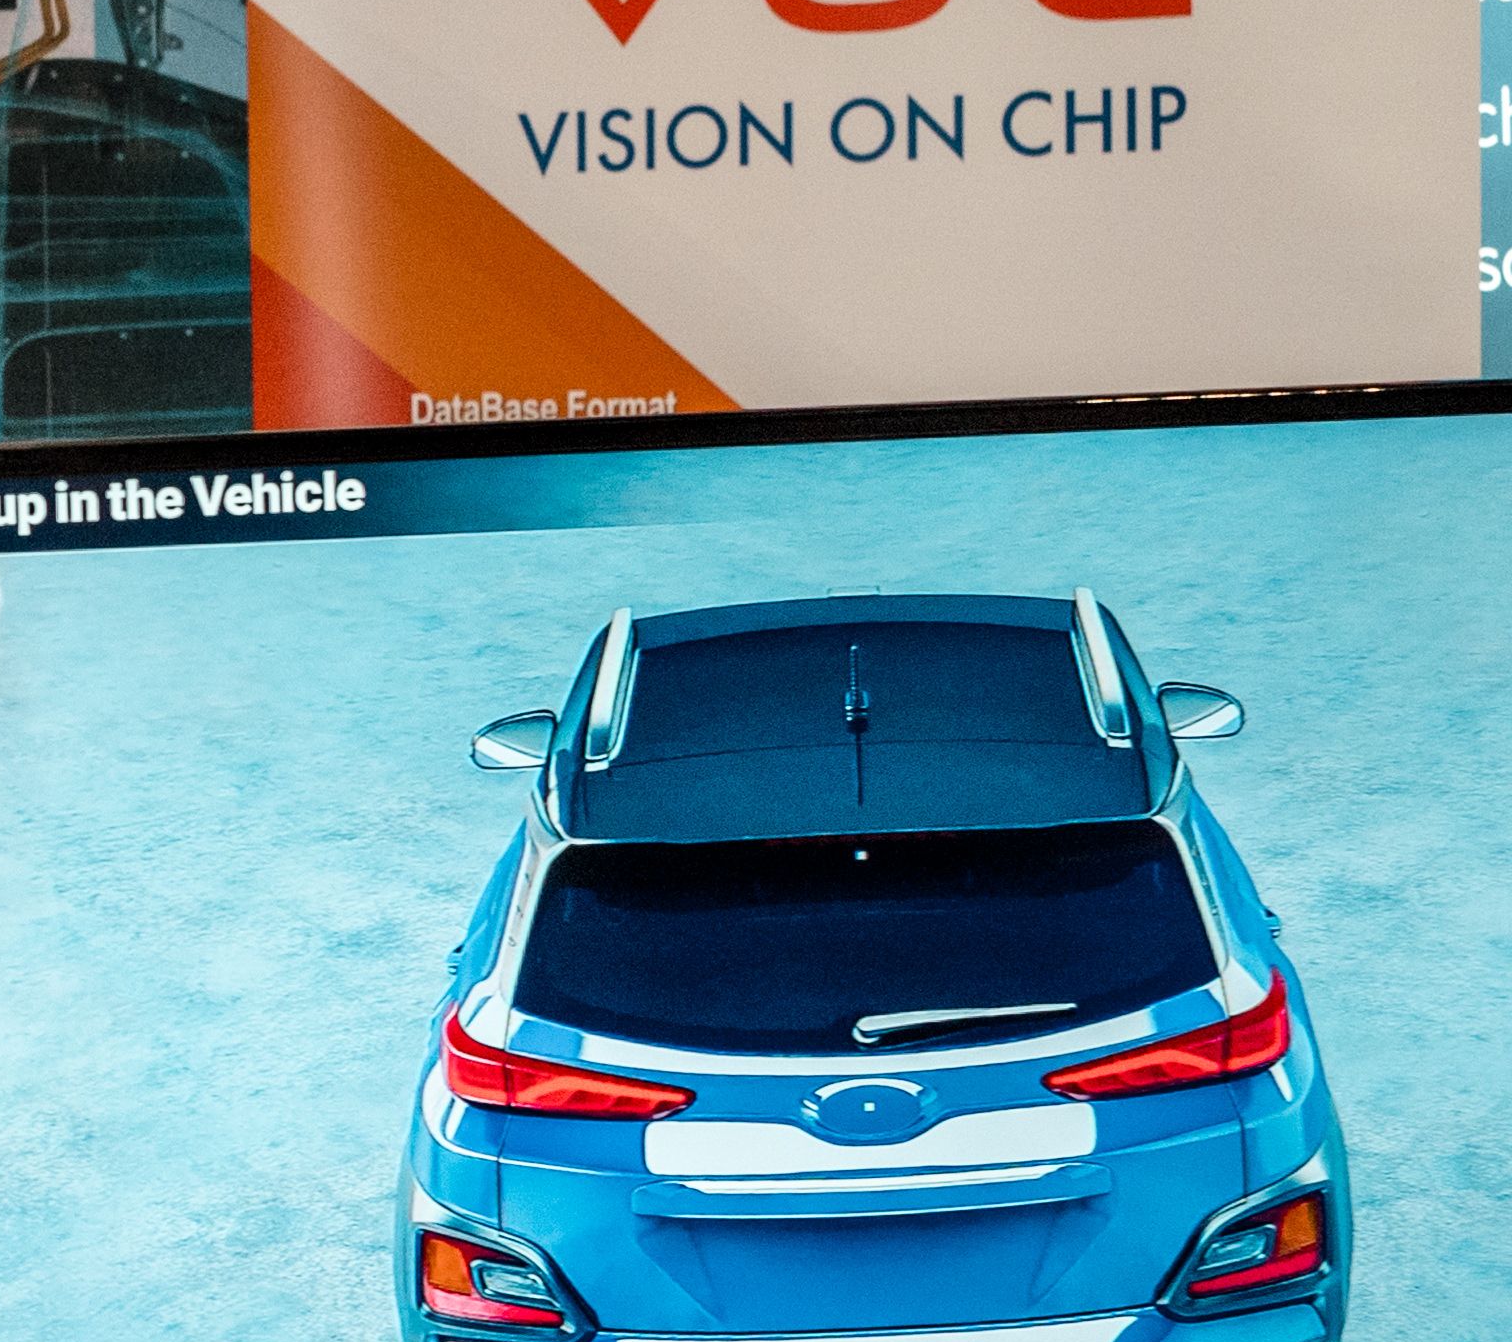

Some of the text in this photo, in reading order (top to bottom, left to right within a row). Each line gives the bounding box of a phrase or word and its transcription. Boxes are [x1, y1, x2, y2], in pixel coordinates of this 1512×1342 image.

[517, 84, 1188, 177] VISION ON CHIP
[410, 389, 677, 424] DataBase Format
[55, 481, 98, 522] in
[106, 479, 183, 519] the
[189, 470, 366, 516] Vehicle
